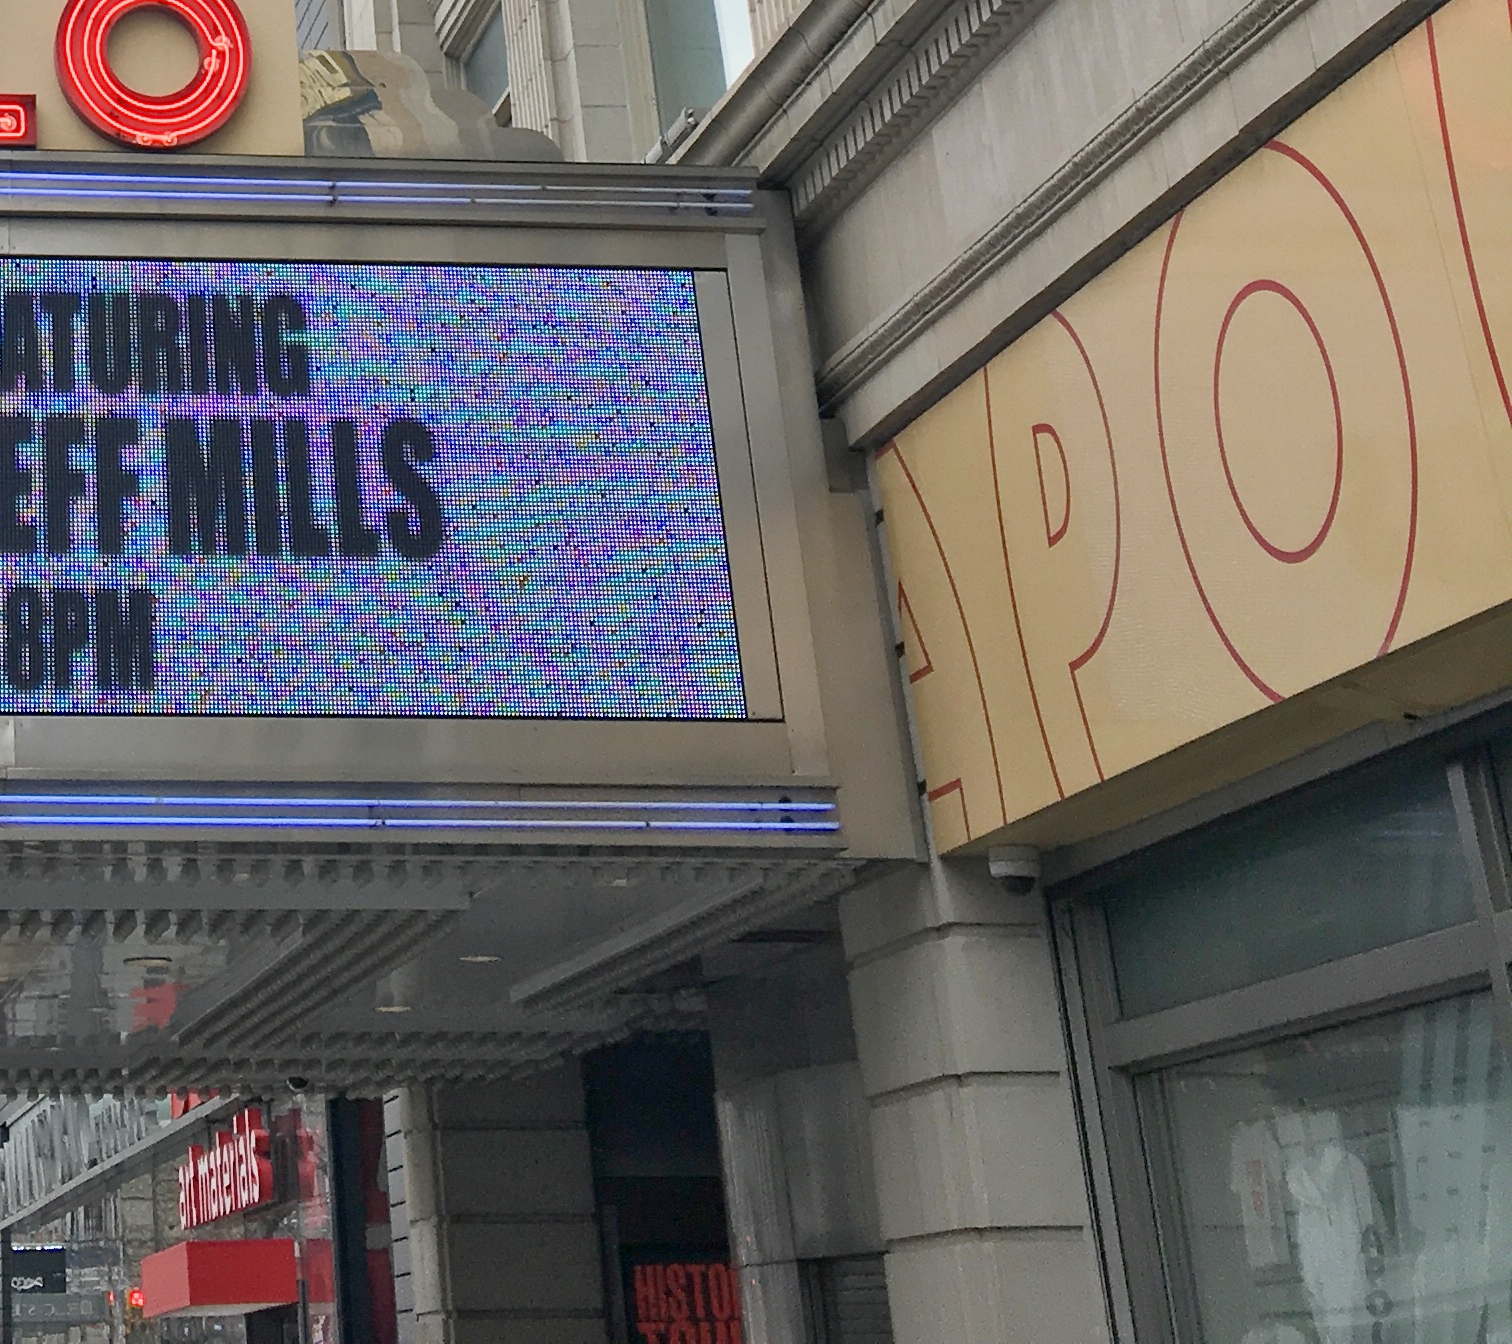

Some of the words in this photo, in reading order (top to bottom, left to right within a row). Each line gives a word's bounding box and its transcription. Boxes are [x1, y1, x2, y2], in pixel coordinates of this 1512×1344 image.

[164, 416, 445, 562] MILLS
[5, 586, 155, 693] 8PM
[178, 1146, 197, 1231] art
[197, 1108, 260, 1224] materials
[633, 1263, 741, 1321] HISTO
